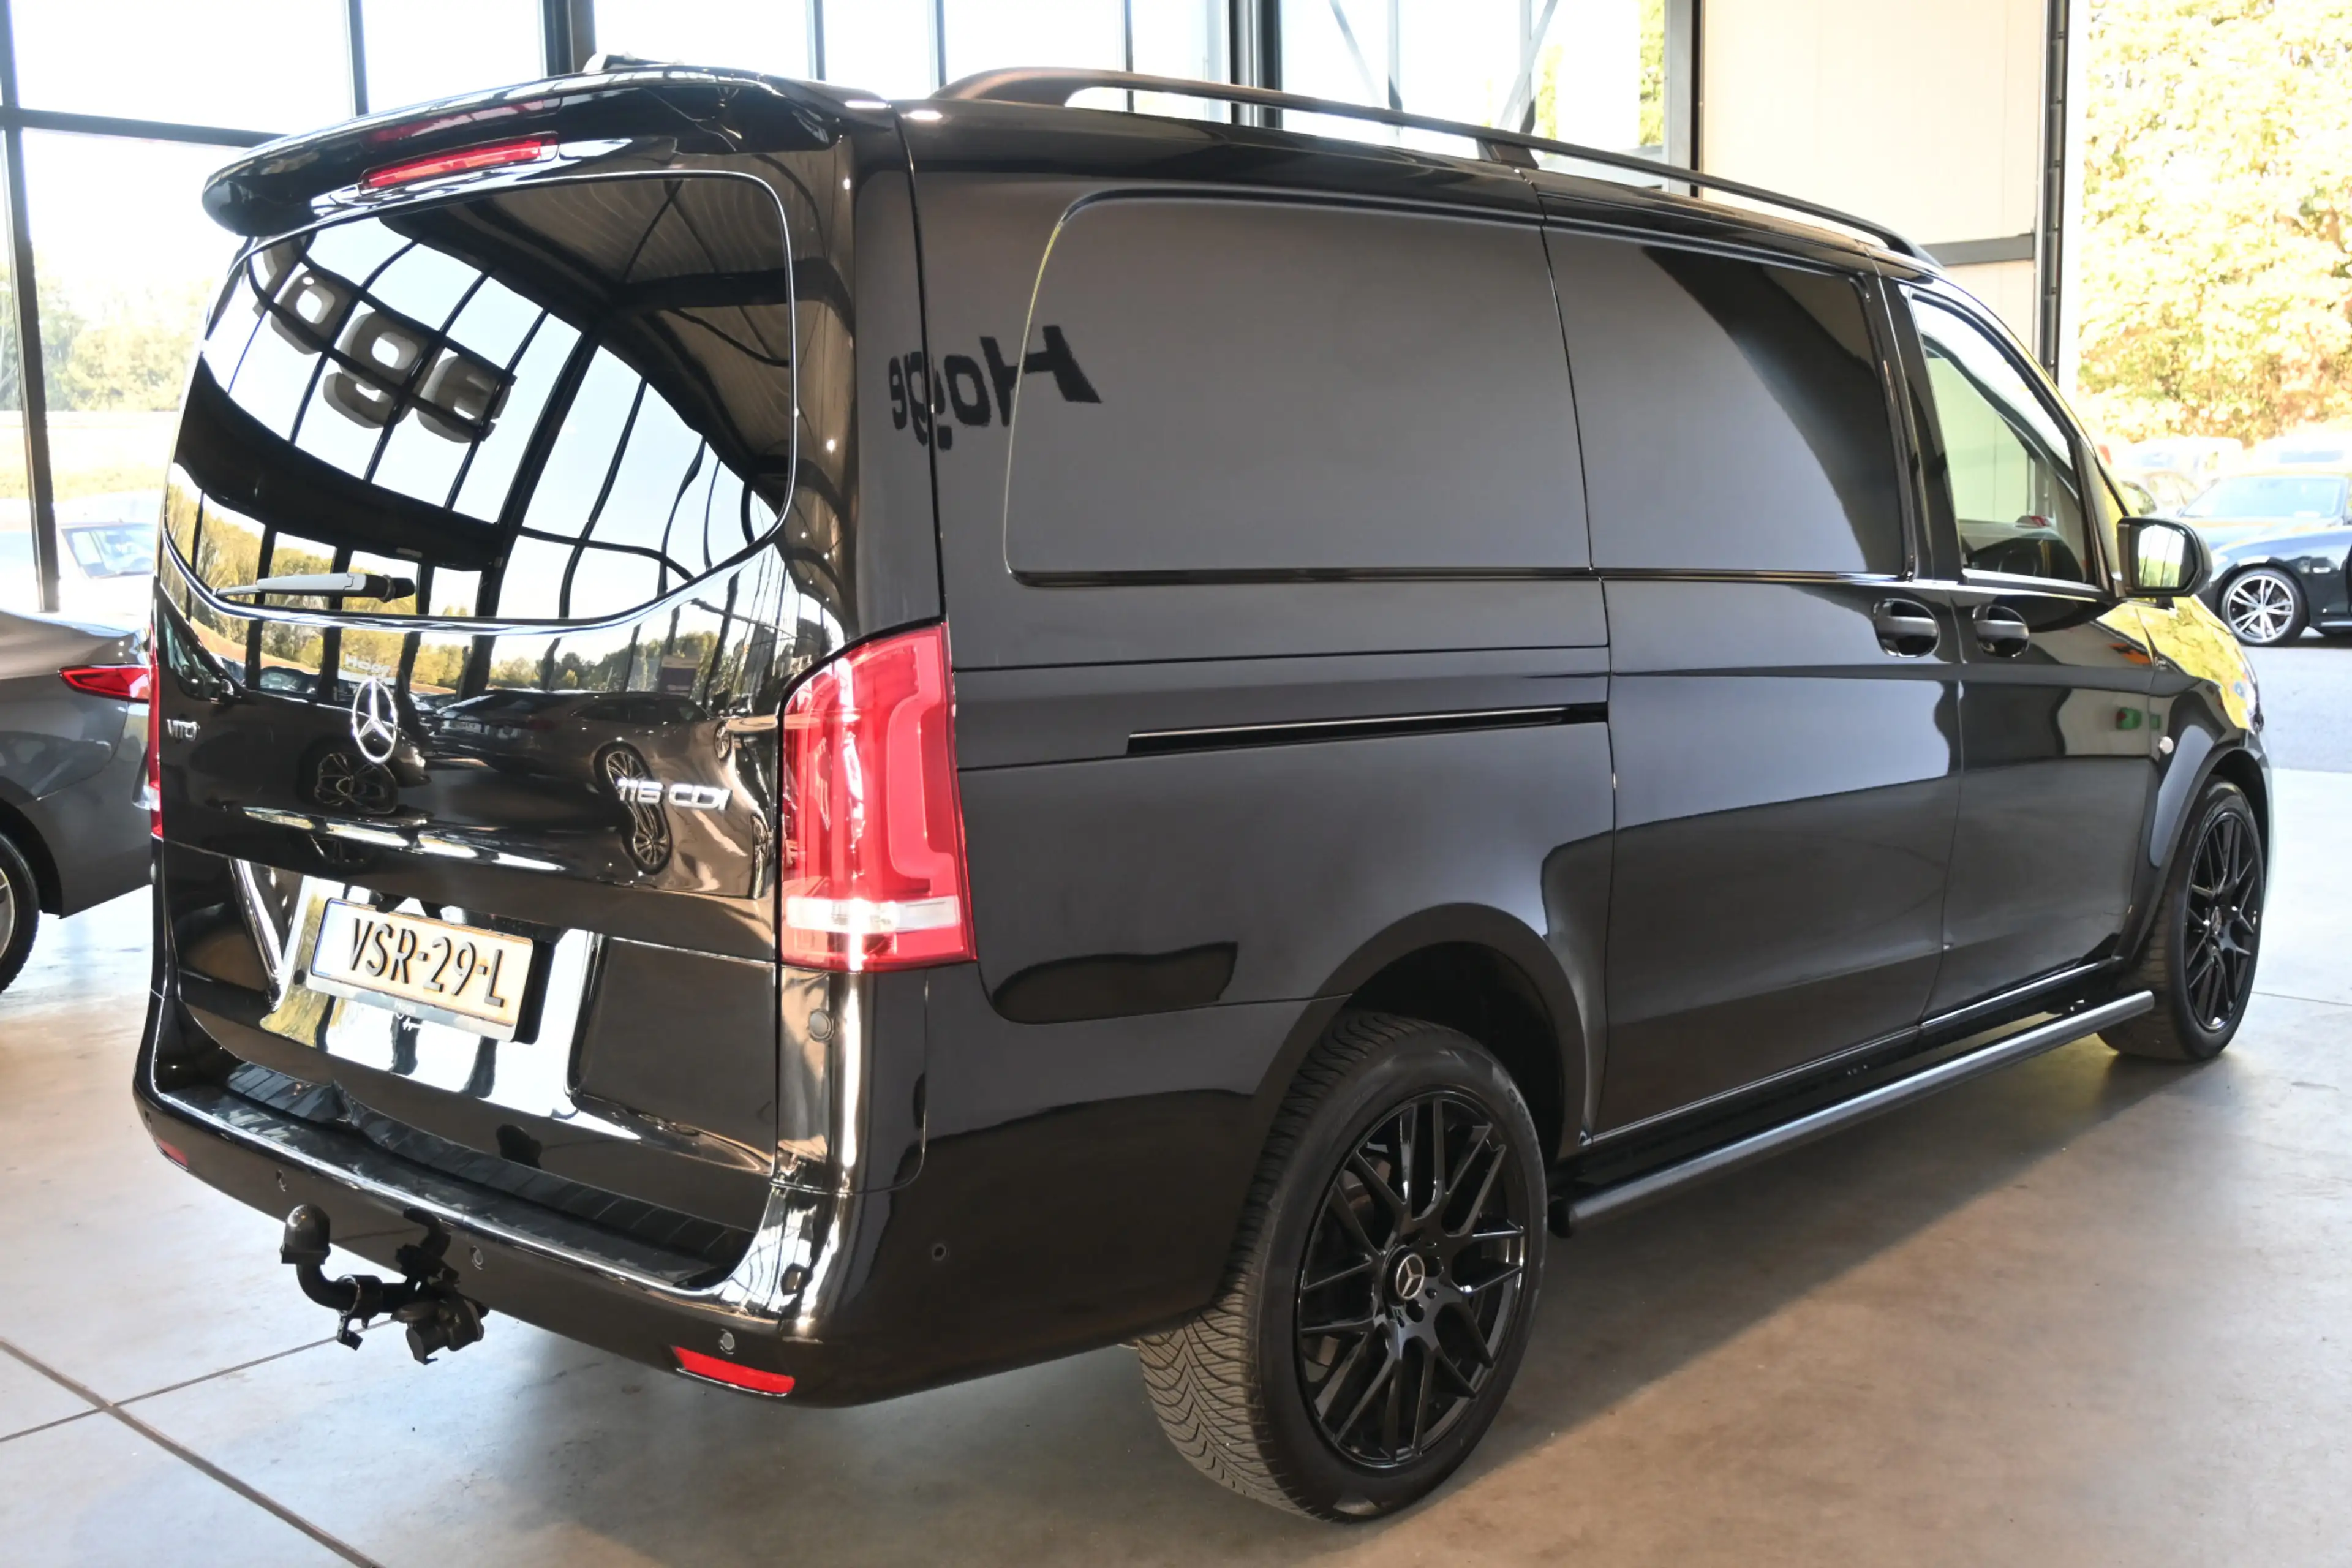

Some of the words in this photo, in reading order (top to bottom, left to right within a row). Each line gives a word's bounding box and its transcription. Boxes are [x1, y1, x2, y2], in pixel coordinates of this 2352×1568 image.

[617, 778, 665, 804] 116
[669, 783, 733, 811] CDI
[349, 918, 505, 1008] VSR-29-L
